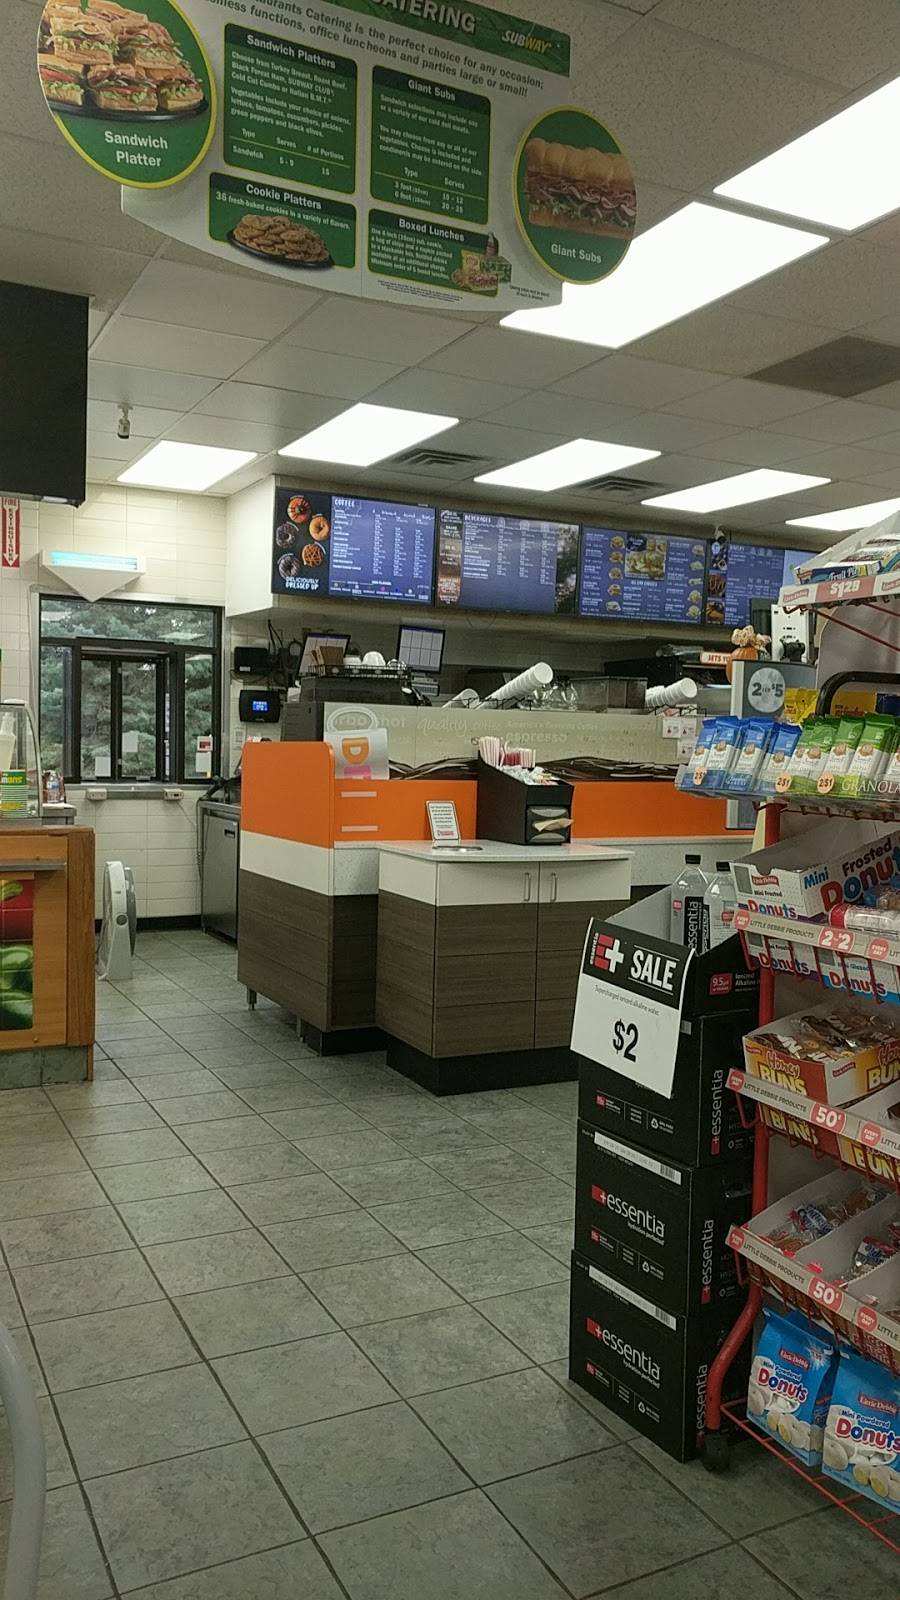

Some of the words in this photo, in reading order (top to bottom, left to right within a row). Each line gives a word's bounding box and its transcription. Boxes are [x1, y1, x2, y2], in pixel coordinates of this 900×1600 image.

[372, 0, 476, 33] TERING
[247, 34, 295, 57] Sandwich
[298, 49, 336, 69] Platters
[250, 5, 306, 32] functions,
[309, 25, 340, 41] office
[343, 37, 397, 58] luncheons
[400, 52, 419, 65] and
[422, 58, 457, 76] parties
[460, 69, 484, 85] large
[486, 78, 497, 88] or
[499, 82, 528, 97] small!
[305, 8, 351, 32] Catering
[355, 22, 364, 34] is
[368, 27, 386, 40] the
[389, 34, 426, 52] perfect
[428, 47, 461, 64] choice
[463, 55, 477, 69] for
[480, 63, 497, 77] any
[502, 30, 550, 54] SUBWAY
[255, 58, 270, 68] from
[271, 62, 290, 75] Turkey
[247, 75, 258, 86] Cut
[288, 77, 314, 90] SUBWAY
[408, 79, 432, 95] Giant
[434, 87, 456, 102] Subs
[230, 86, 264, 102] Vegetables
[265, 95, 288, 108] include
[288, 103, 302, 112] your
[275, 119, 287, 128] and
[288, 121, 305, 133] black
[105, 130, 168, 150] Sandwich
[116, 151, 162, 167] Platter
[232, 145, 264, 160] Sandwich
[246, 183, 281, 200] Cookie
[283, 192, 322, 210] Platters
[265, 205, 289, 216] cookies
[290, 209, 296, 217] in
[302, 213, 322, 225] variety
[398, 218, 427, 233] Boxed
[429, 225, 465, 242] Lunches
[551, 243, 577, 258] Giant
[579, 250, 602, 264] Subs
[286, 576, 319, 585] DELICIOUSLY
[752, 682, 762, 697] 2
[771, 683, 784, 699] $5
[804, 866, 829, 890] Mini
[842, 837, 892, 877] Frosted
[748, 899, 797, 919] Donuts
[750, 920, 766, 928] LITTLE
[785, 928, 815, 939] PRODUCTS
[821, 930, 833, 947] 2
[630, 949, 677, 991] SALE
[829, 971, 888, 997] Dnus
[612, 1018, 639, 1063] $2
[766, 1050, 801, 1079] Honey
[759, 1063, 808, 1096] BUNS
[711, 1069, 723, 1136] essentia
[743, 1083, 760, 1094] LITTLE
[778, 1096, 807, 1112] PRODUCTS
[606, 1193, 665, 1238] essentia
[701, 1219, 714, 1285] essentia
[743, 1243, 759, 1256] LITTLE
[777, 1261, 805, 1285] PRODUCTS
[877, 1324, 899, 1341] LITTLE
[602, 1329, 661, 1381] essentia
[780, 1349, 793, 1362] Little
[696, 1364, 708, 1430] essentia
[758, 1367, 809, 1403] Donuts
[860, 1394, 879, 1409] Little
[841, 1409, 855, 1419] Mini
[856, 1413, 891, 1429] Powdered
